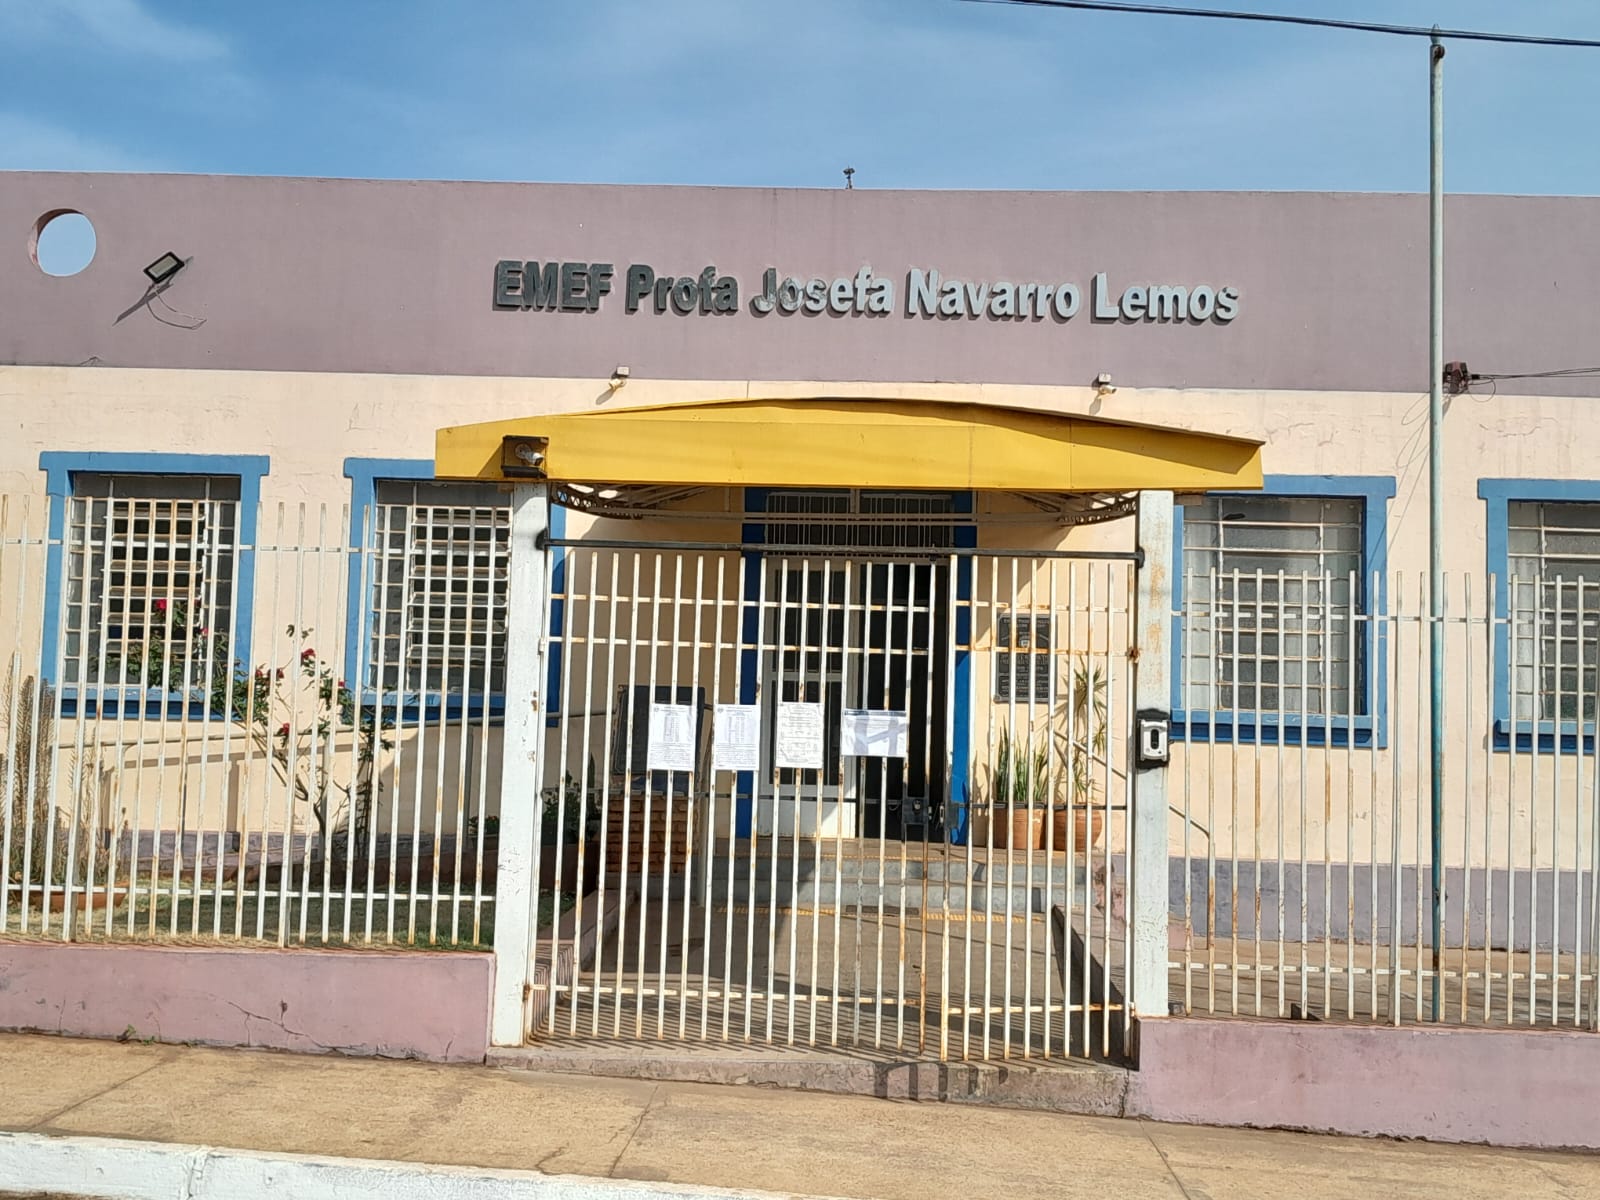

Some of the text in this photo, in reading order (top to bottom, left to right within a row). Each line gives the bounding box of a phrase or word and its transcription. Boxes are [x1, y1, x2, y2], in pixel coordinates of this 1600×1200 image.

[494, 260, 1240, 324] EMEF Profa Josefa Navarro Lemos
